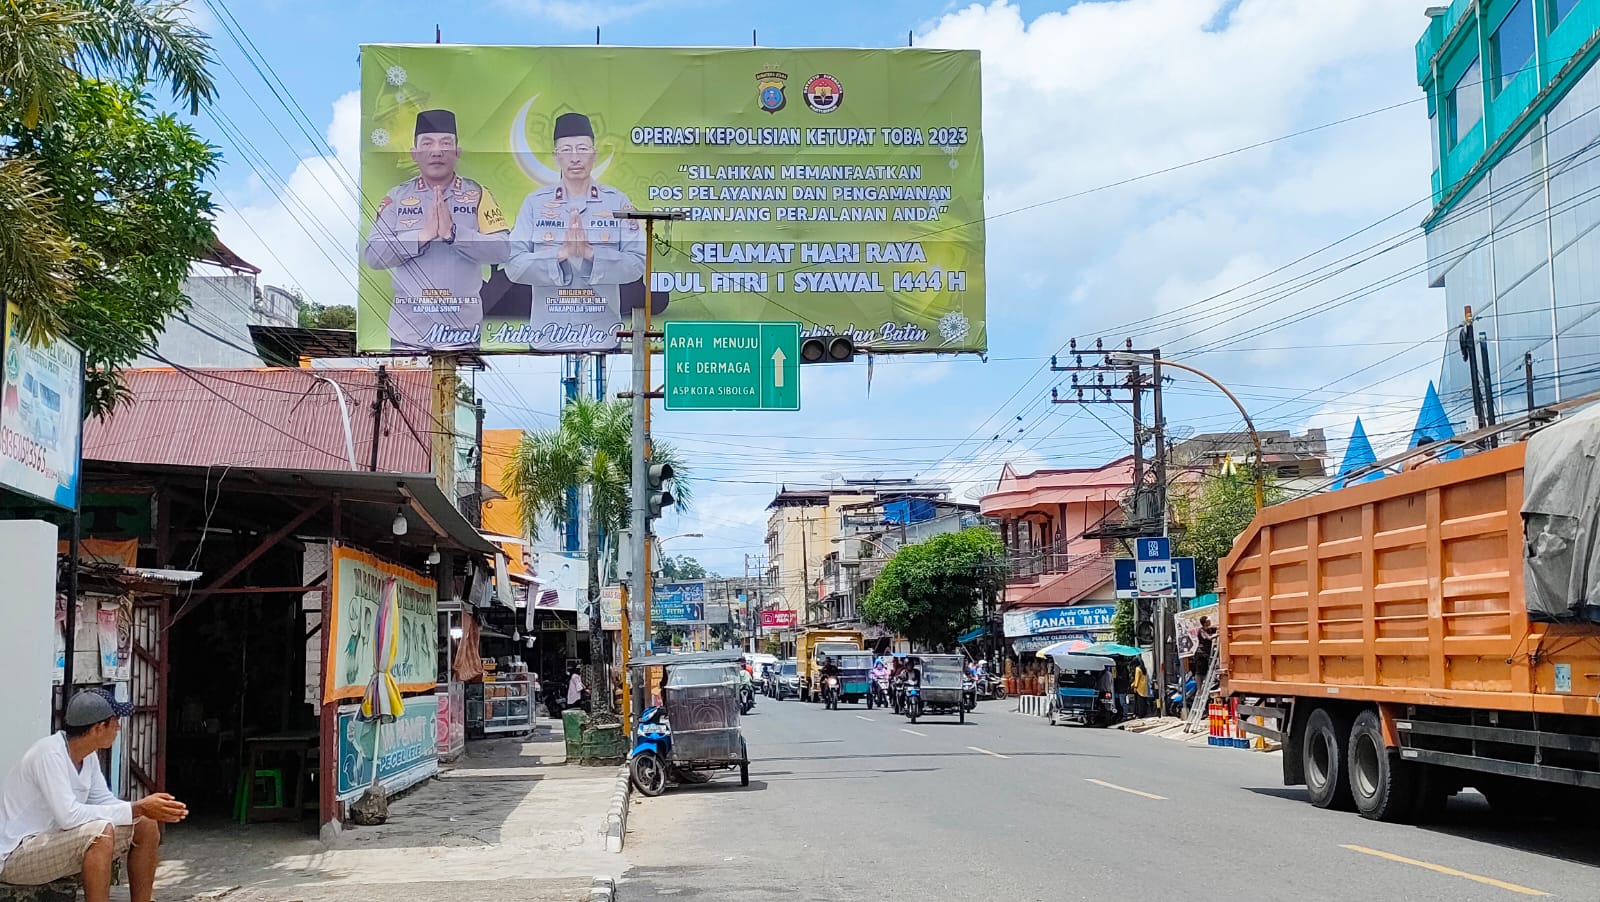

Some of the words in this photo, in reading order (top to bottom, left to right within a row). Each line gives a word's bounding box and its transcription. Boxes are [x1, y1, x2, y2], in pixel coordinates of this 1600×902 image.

[631, 127, 700, 145] OPERASI
[705, 127, 801, 145] KEPOLISIAN
[806, 127, 876, 145] KETUPAT
[881, 127, 923, 145] TOBA
[928, 127, 968, 145] 2023
[781, 165, 921, 180] MEMANFAATKAN
[649, 186, 683, 200] POS
[688, 186, 786, 200] PELAYANAN
[792, 186, 827, 200] DAN
[832, 186, 951, 200] PENGAMANAN
[397, 207, 423, 216] PANCA
[776, 206, 886, 221] PERJALANAN
[536, 220, 564, 228] JAWARI
[590, 220, 618, 228] POLRI
[690, 242, 796, 263] SELAMAT
[801, 242, 860, 263] HARI
[866, 242, 927, 263] RAYA
[650, 272, 706, 293] IDUL
[711, 272, 768, 293] FITRI
[794, 272, 885, 293] SYAWAL
[893, 271, 942, 292] 1444
[948, 271, 967, 292] H
[548, 305, 583, 313] WAKAPOLDA
[419, 322, 481, 344] Minal
[843, 322, 877, 342] dan
[880, 321, 930, 342] Batin
[670, 337, 703, 349] ARAH
[713, 337, 758, 349] MENUJU
[676, 362, 690, 373] KE
[696, 362, 751, 374] DERMAGA
[718, 386, 755, 395] SIBOLGA
[1144, 566, 1166, 574] ATM
